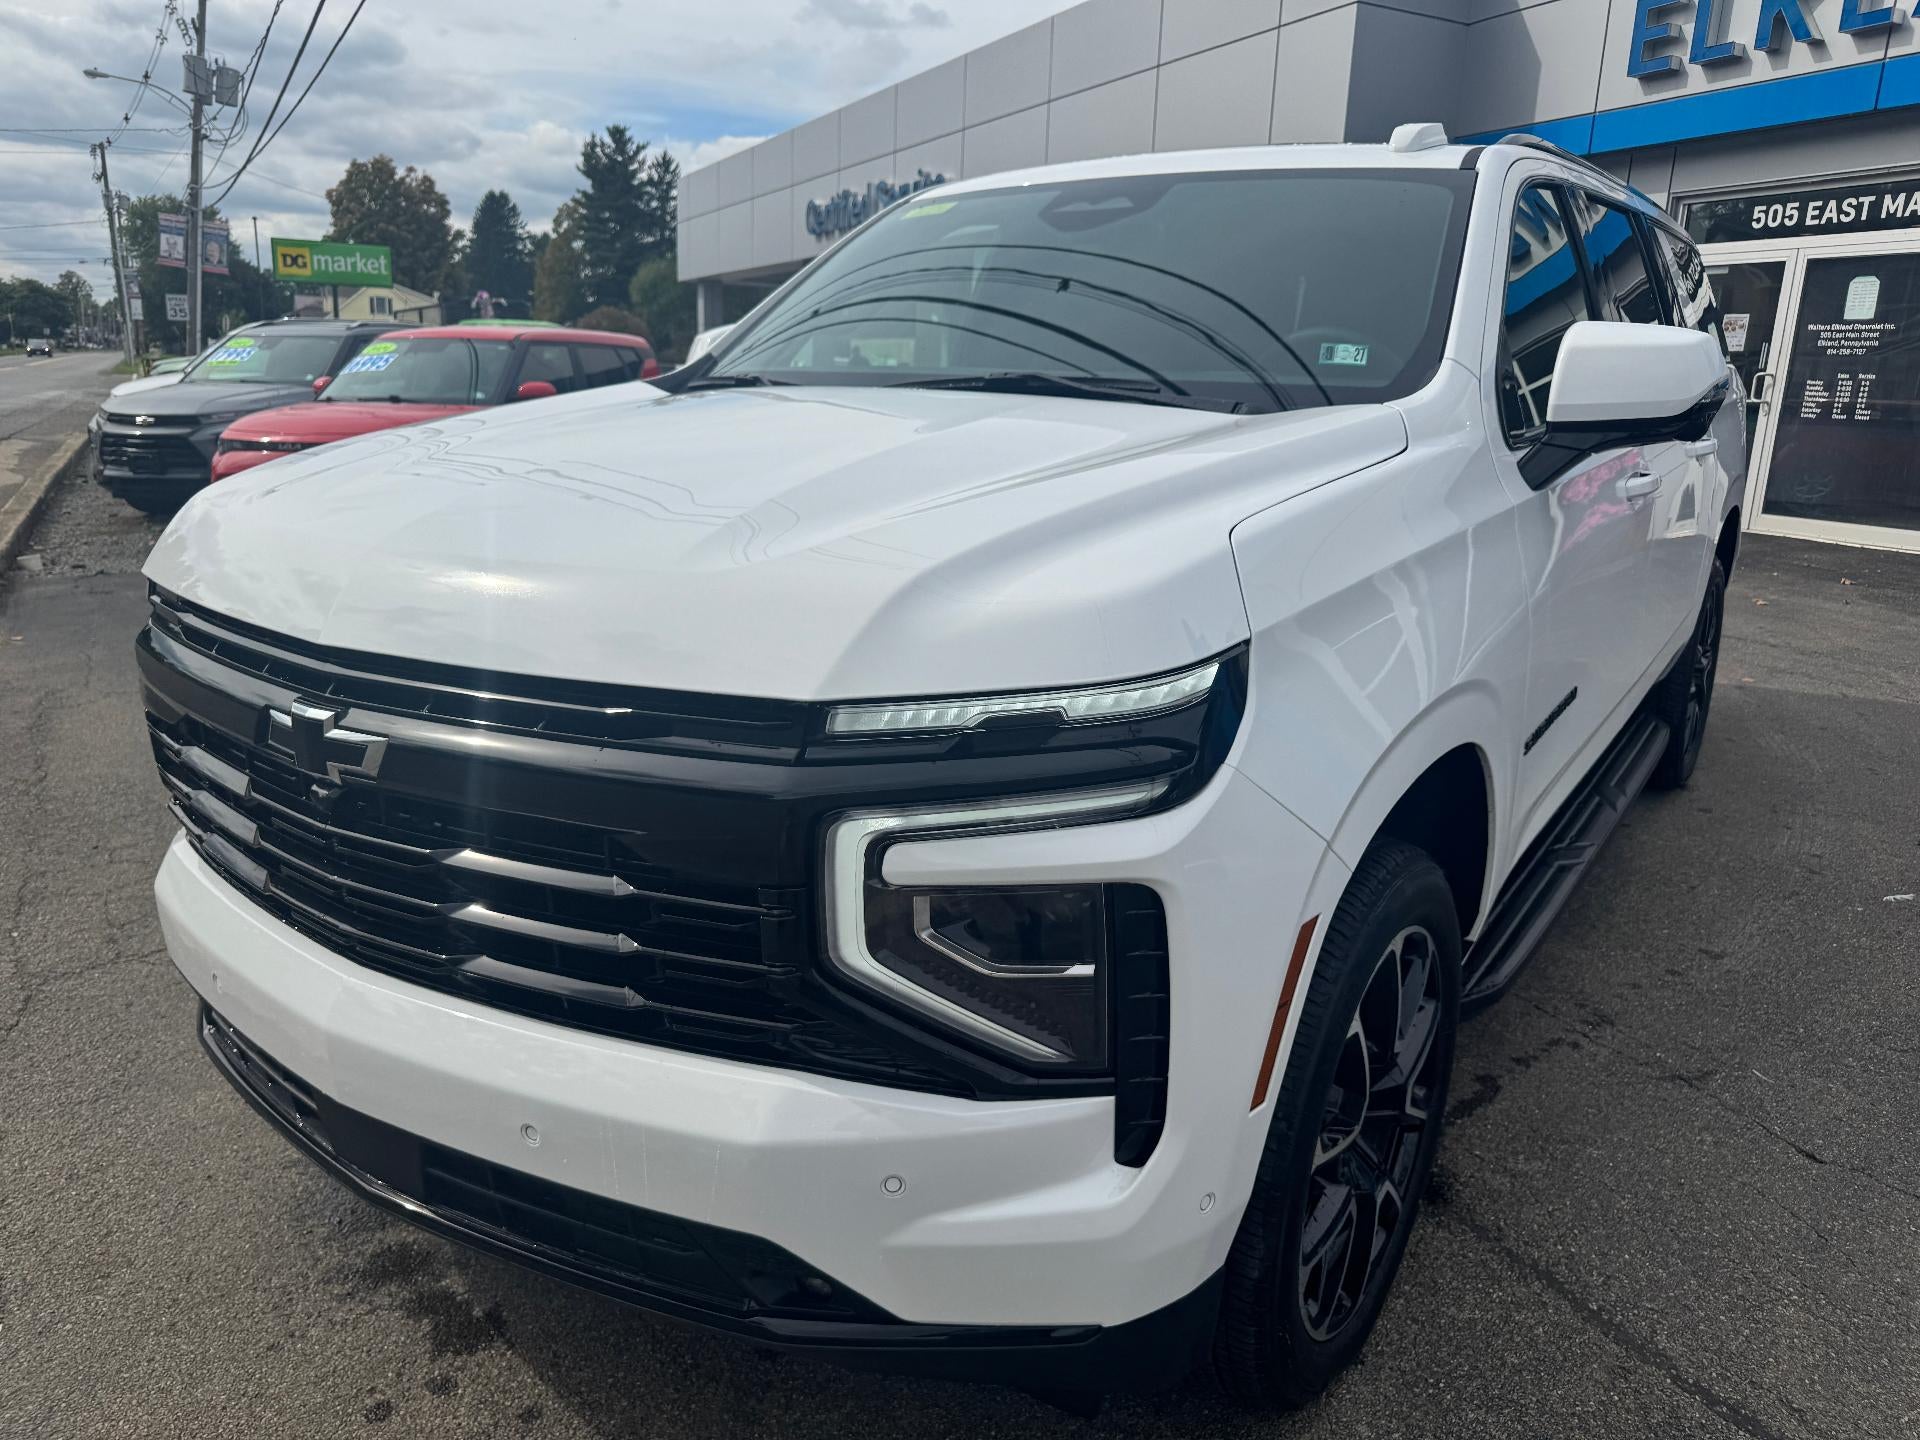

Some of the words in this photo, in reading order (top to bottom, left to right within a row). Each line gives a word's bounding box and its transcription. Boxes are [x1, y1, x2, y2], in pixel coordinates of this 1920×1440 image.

[1627, 0, 1920, 77] ELKL
[1751, 202, 1799, 229] 505
[1805, 196, 1876, 226] EAST
[280, 253, 308, 269] DG
[313, 251, 389, 275] market
[169, 307, 187, 318] 35
[1831, 323, 1853, 331] Elkland
[1840, 339, 1879, 348] Pennsylvania
[1353, 347, 1366, 362] 27
